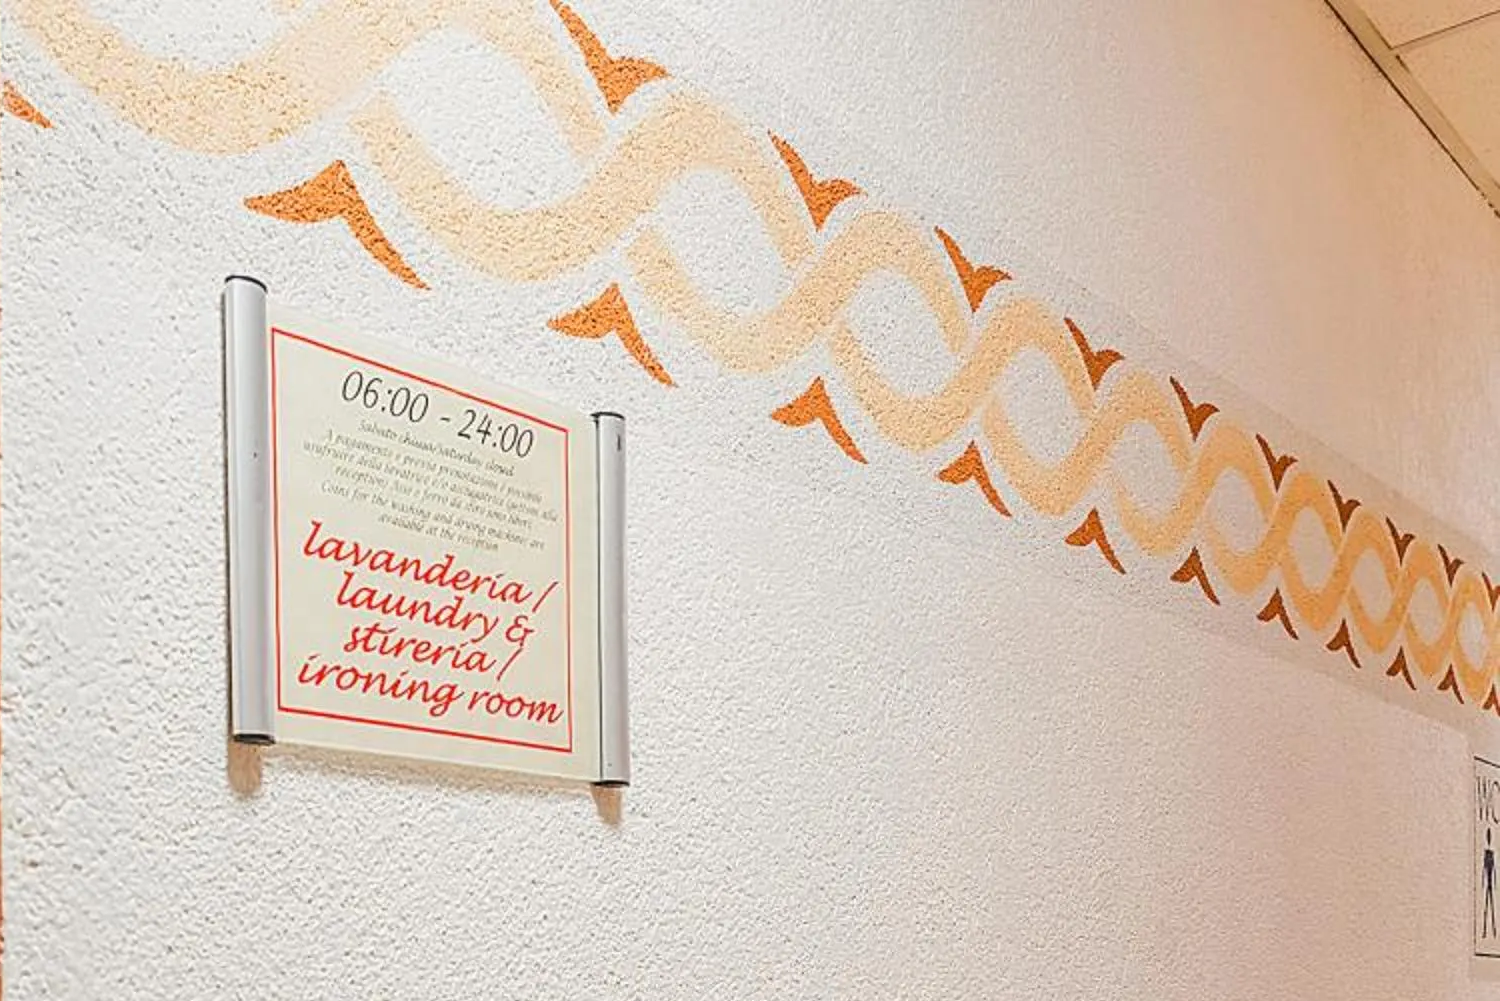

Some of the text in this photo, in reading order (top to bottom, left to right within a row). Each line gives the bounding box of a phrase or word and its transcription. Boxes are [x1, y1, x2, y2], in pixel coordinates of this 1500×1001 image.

[342, 372, 428, 422] 06:00
[458, 410, 533, 457] 24:00
[337, 571, 534, 649] laundry &
[298, 655, 564, 723] ironing room
